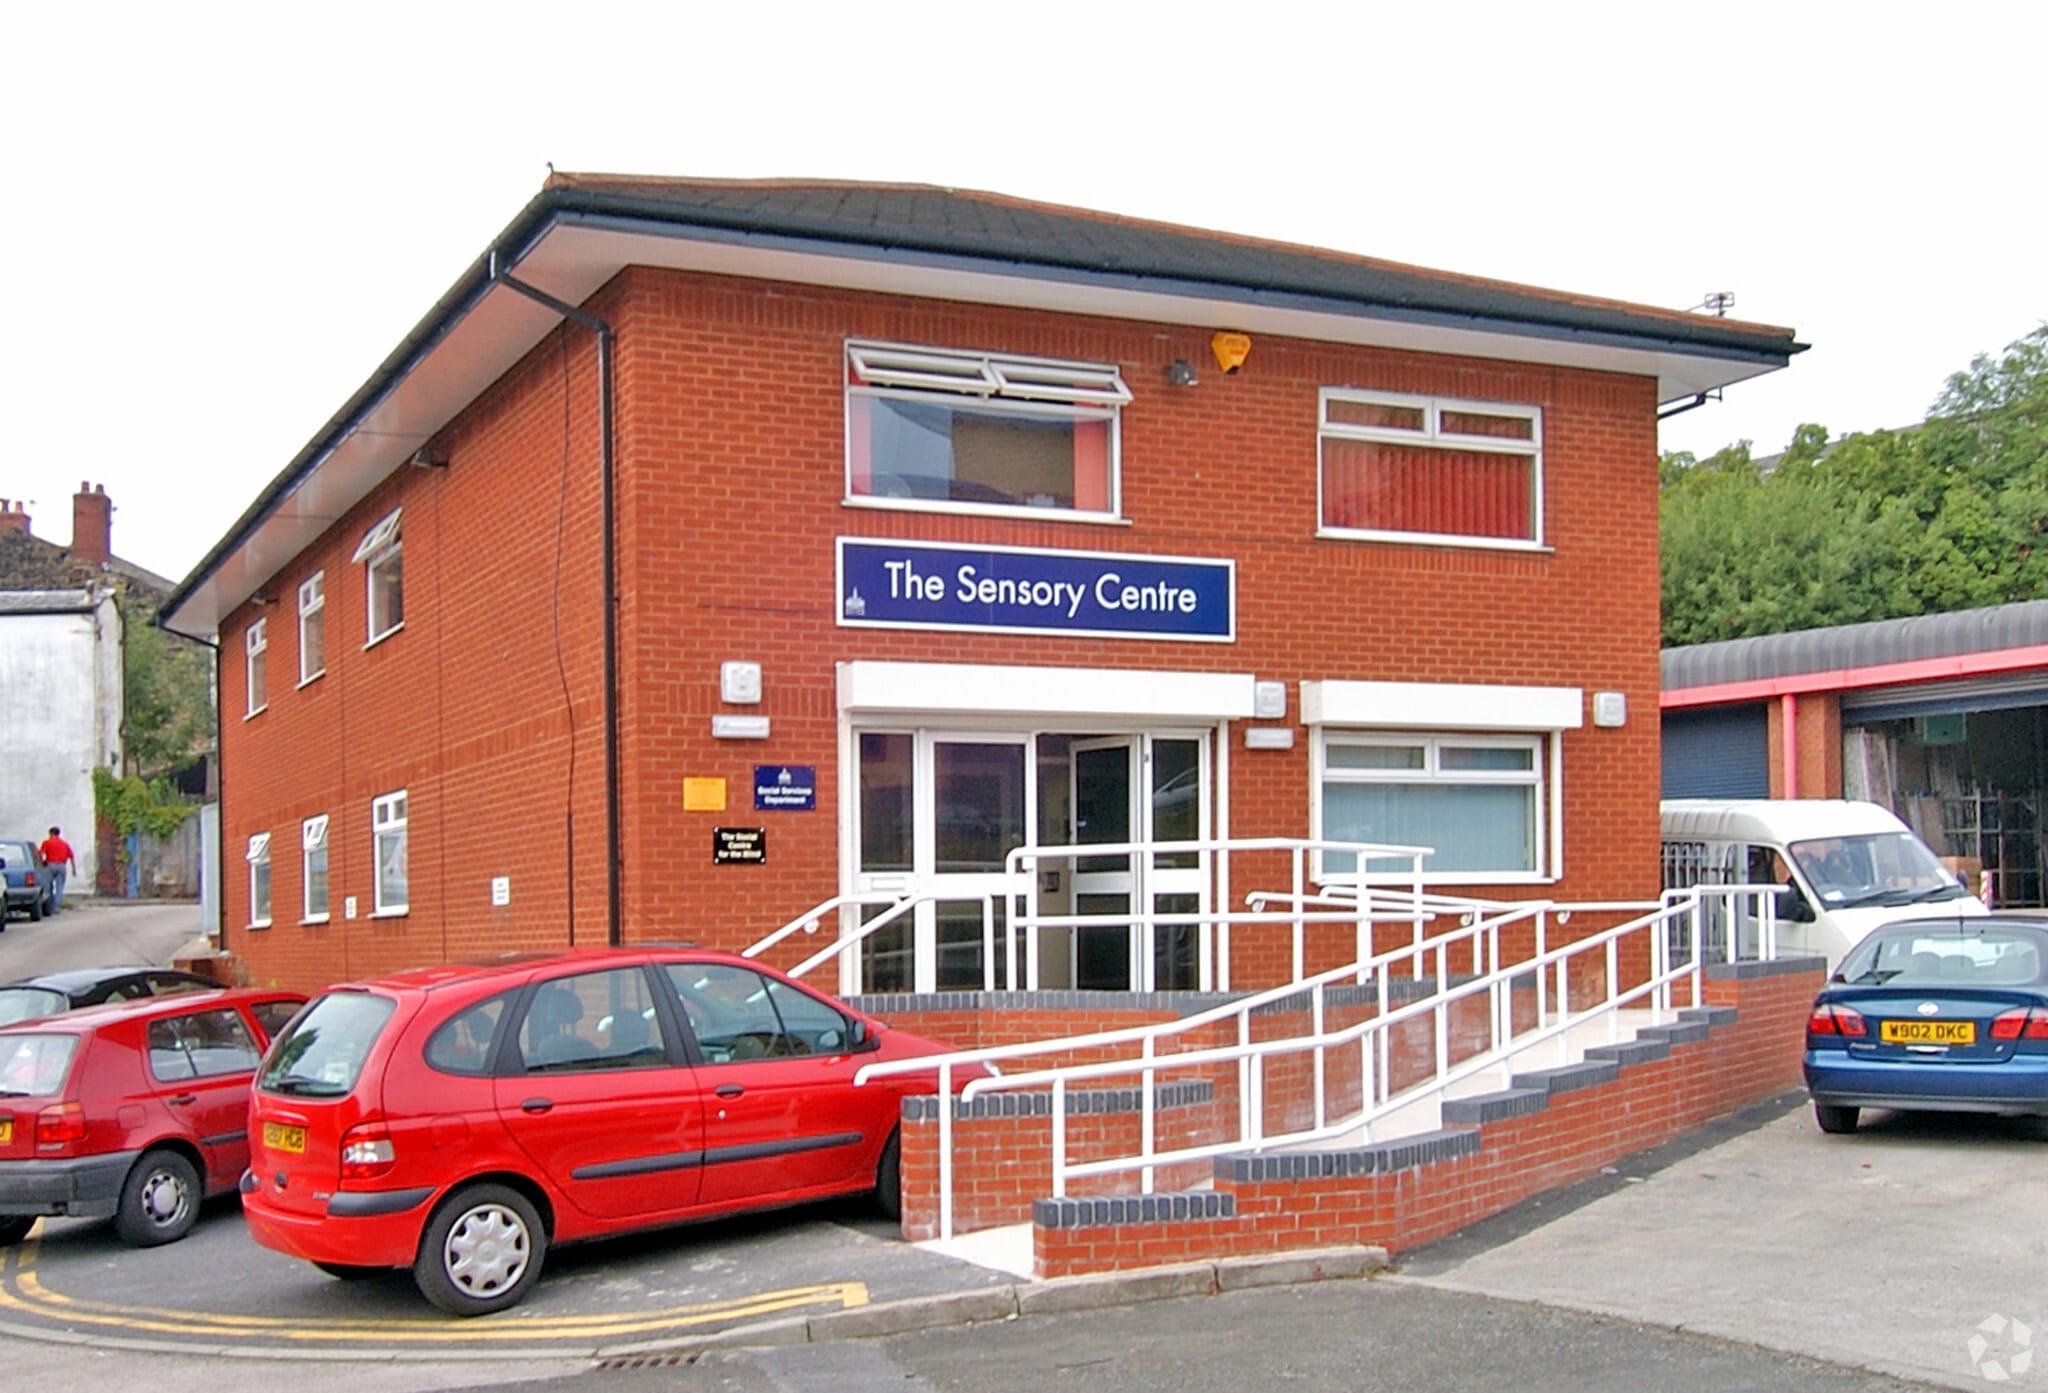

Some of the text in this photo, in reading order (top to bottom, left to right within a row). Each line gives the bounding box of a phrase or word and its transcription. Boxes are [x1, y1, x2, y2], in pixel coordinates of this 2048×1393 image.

[884, 560, 1197, 618] The Sensory Centre
[1888, 1024, 1967, 1039] W902 DKC
